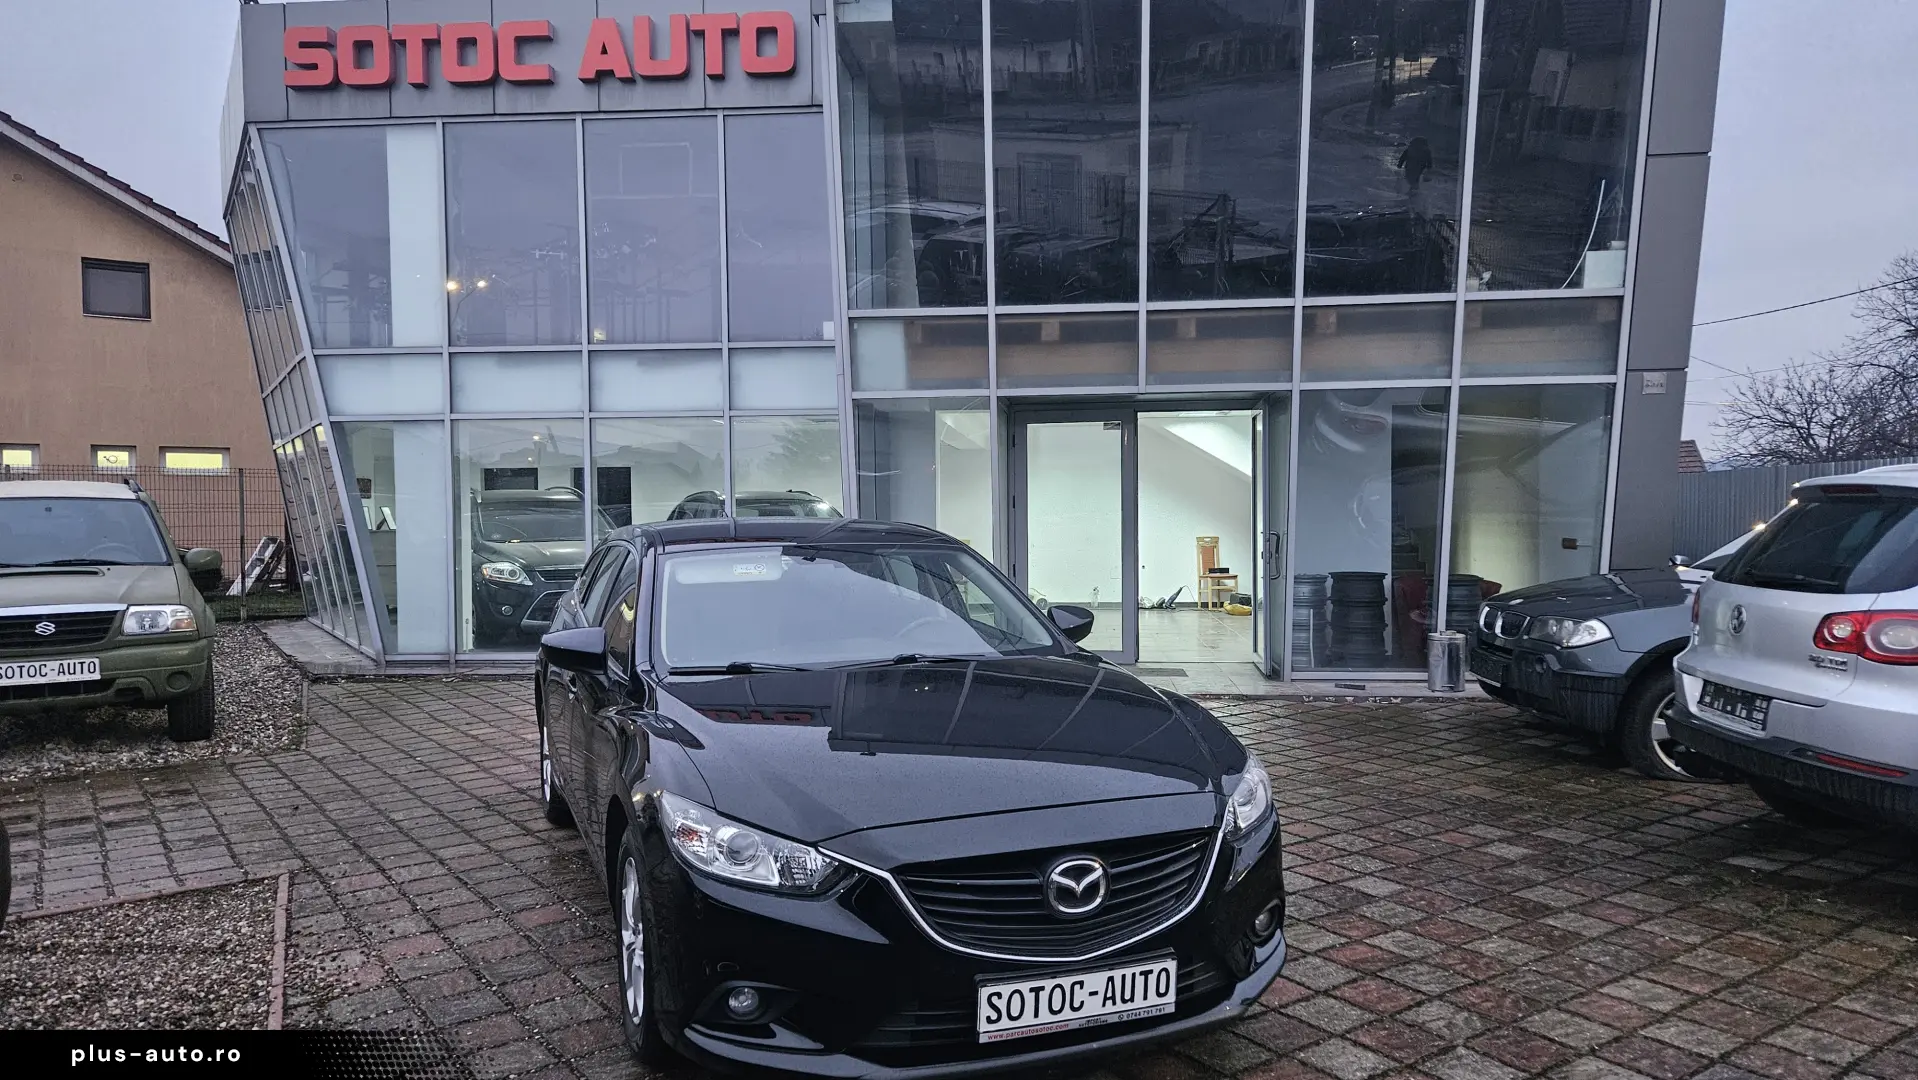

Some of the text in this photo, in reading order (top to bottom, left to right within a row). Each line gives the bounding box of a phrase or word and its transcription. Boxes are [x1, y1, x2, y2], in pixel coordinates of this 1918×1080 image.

[284, 11, 797, 89] SOTOC AUTO
[986, 967, 1171, 1025] SOTOC-AUTO
